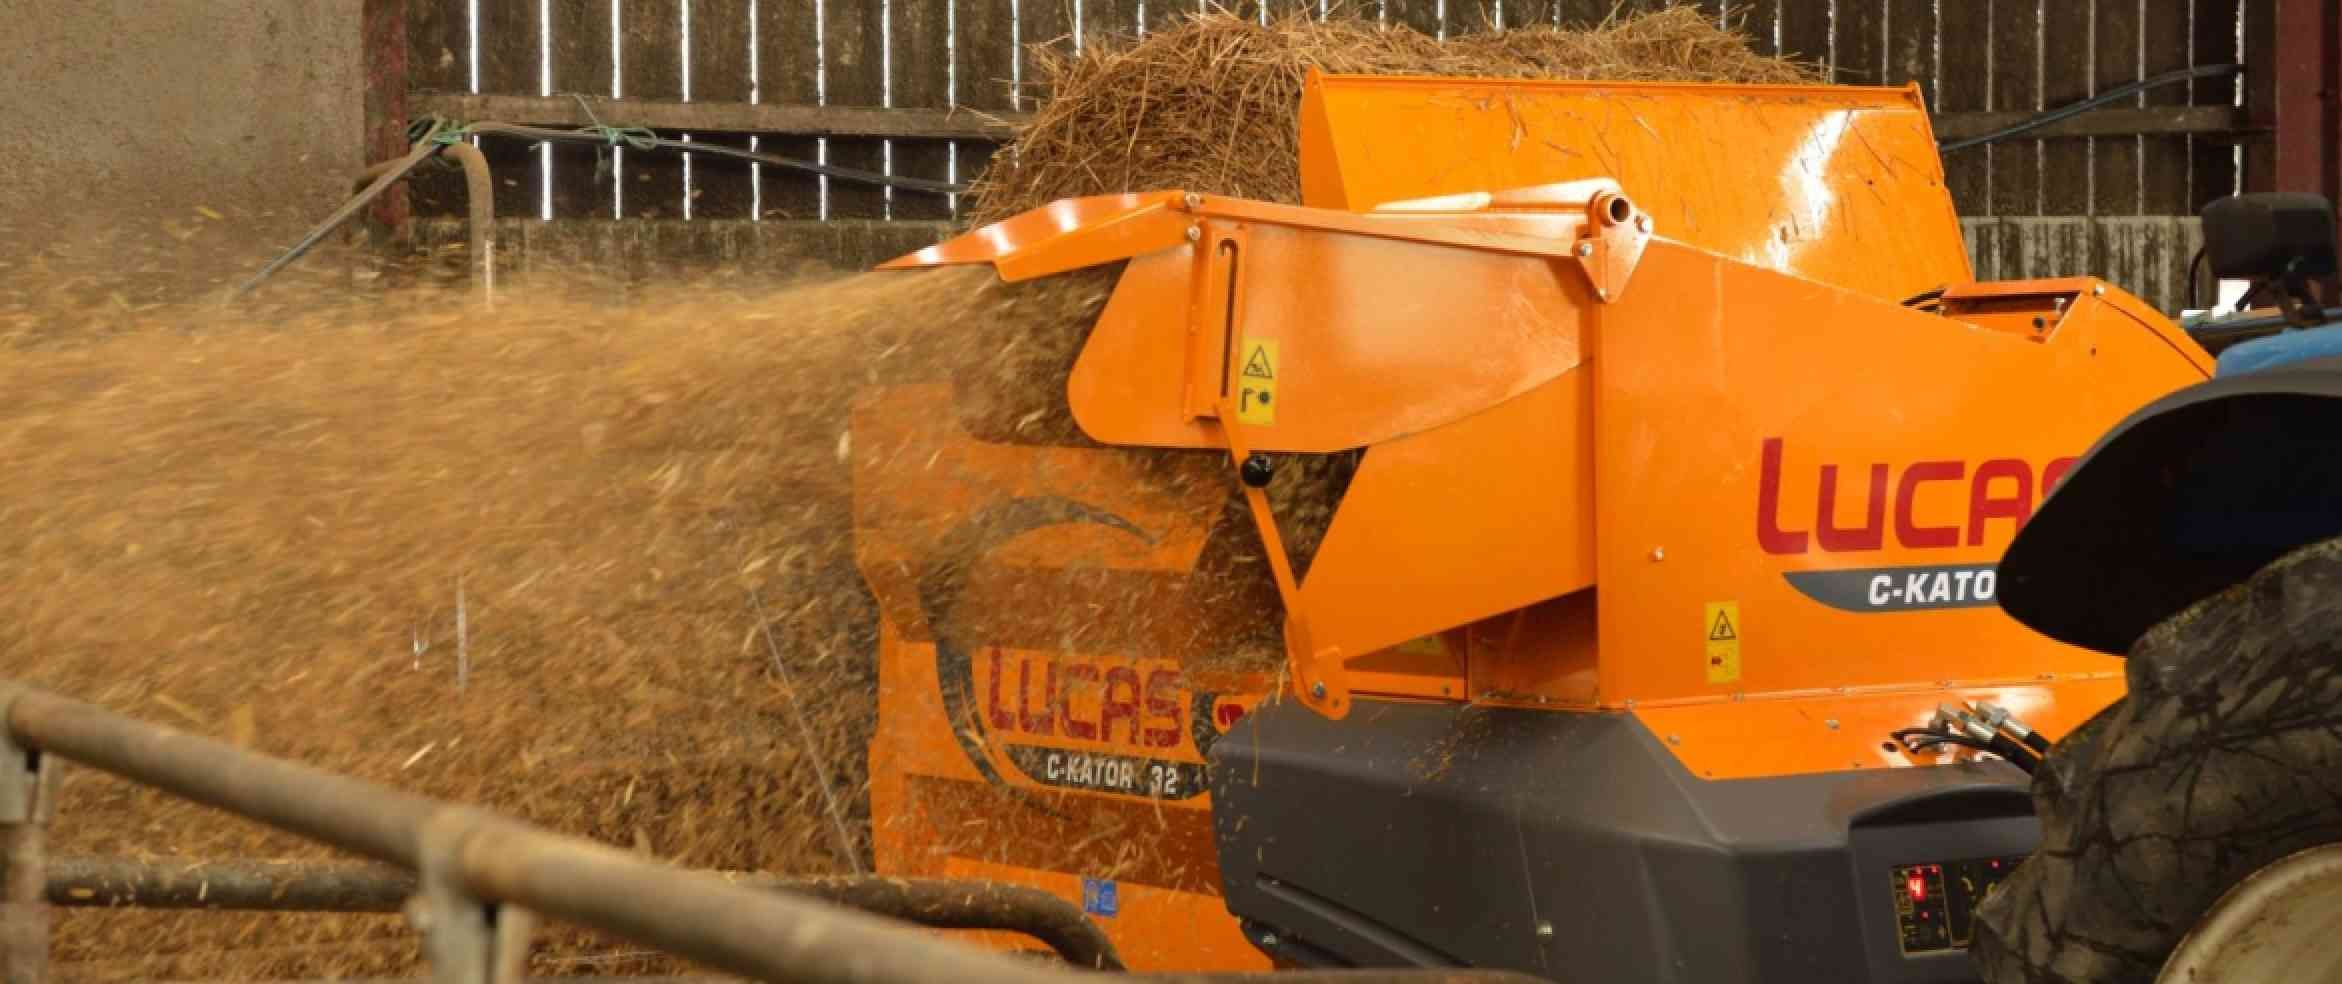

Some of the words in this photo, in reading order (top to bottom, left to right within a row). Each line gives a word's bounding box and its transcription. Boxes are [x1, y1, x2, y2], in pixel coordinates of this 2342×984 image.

[1868, 569, 1996, 606] C-KATO
[988, 645, 1183, 748] LUCAS
[1046, 753, 1133, 789] C-KATOR
[1150, 764, 1178, 795] 32
